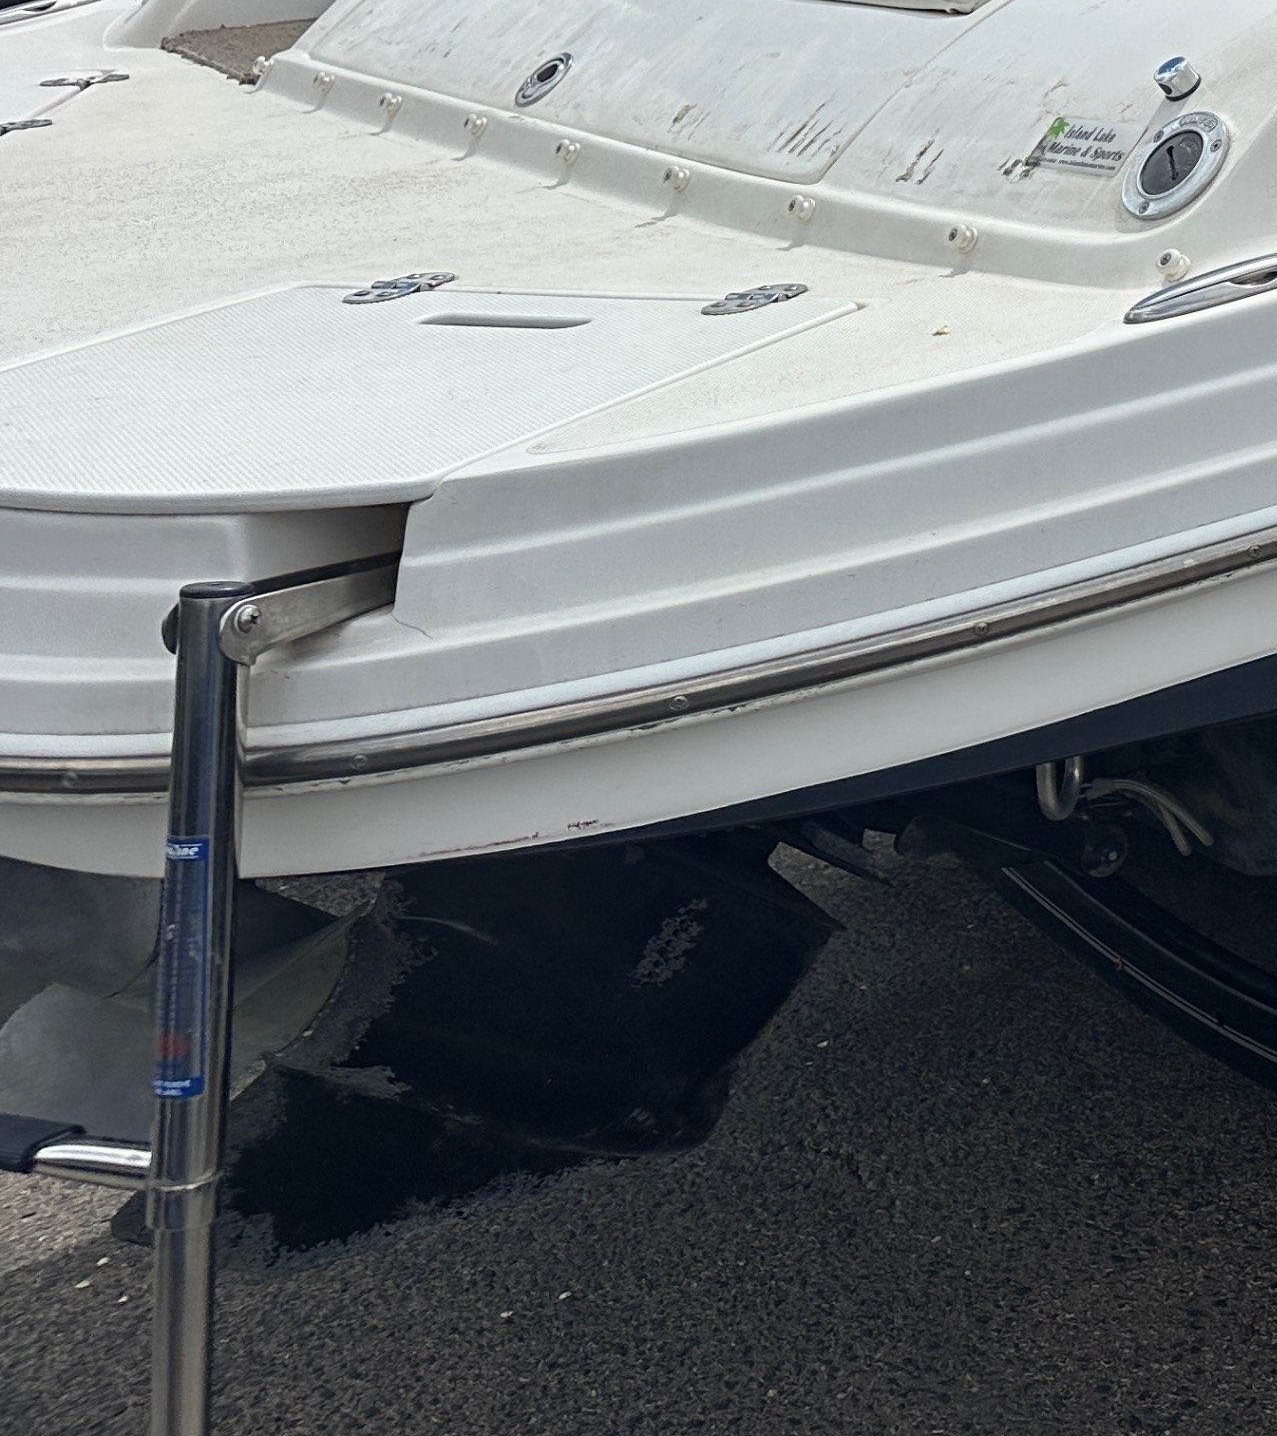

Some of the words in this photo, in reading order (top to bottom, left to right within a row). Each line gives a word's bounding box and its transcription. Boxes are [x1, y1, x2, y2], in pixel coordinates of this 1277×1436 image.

[1064, 124, 1098, 141] Island
[1093, 126, 1116, 143] Lake
[1047, 141, 1081, 157] Marine
[1080, 145, 1093, 158] &
[1091, 146, 1125, 161] Sports
